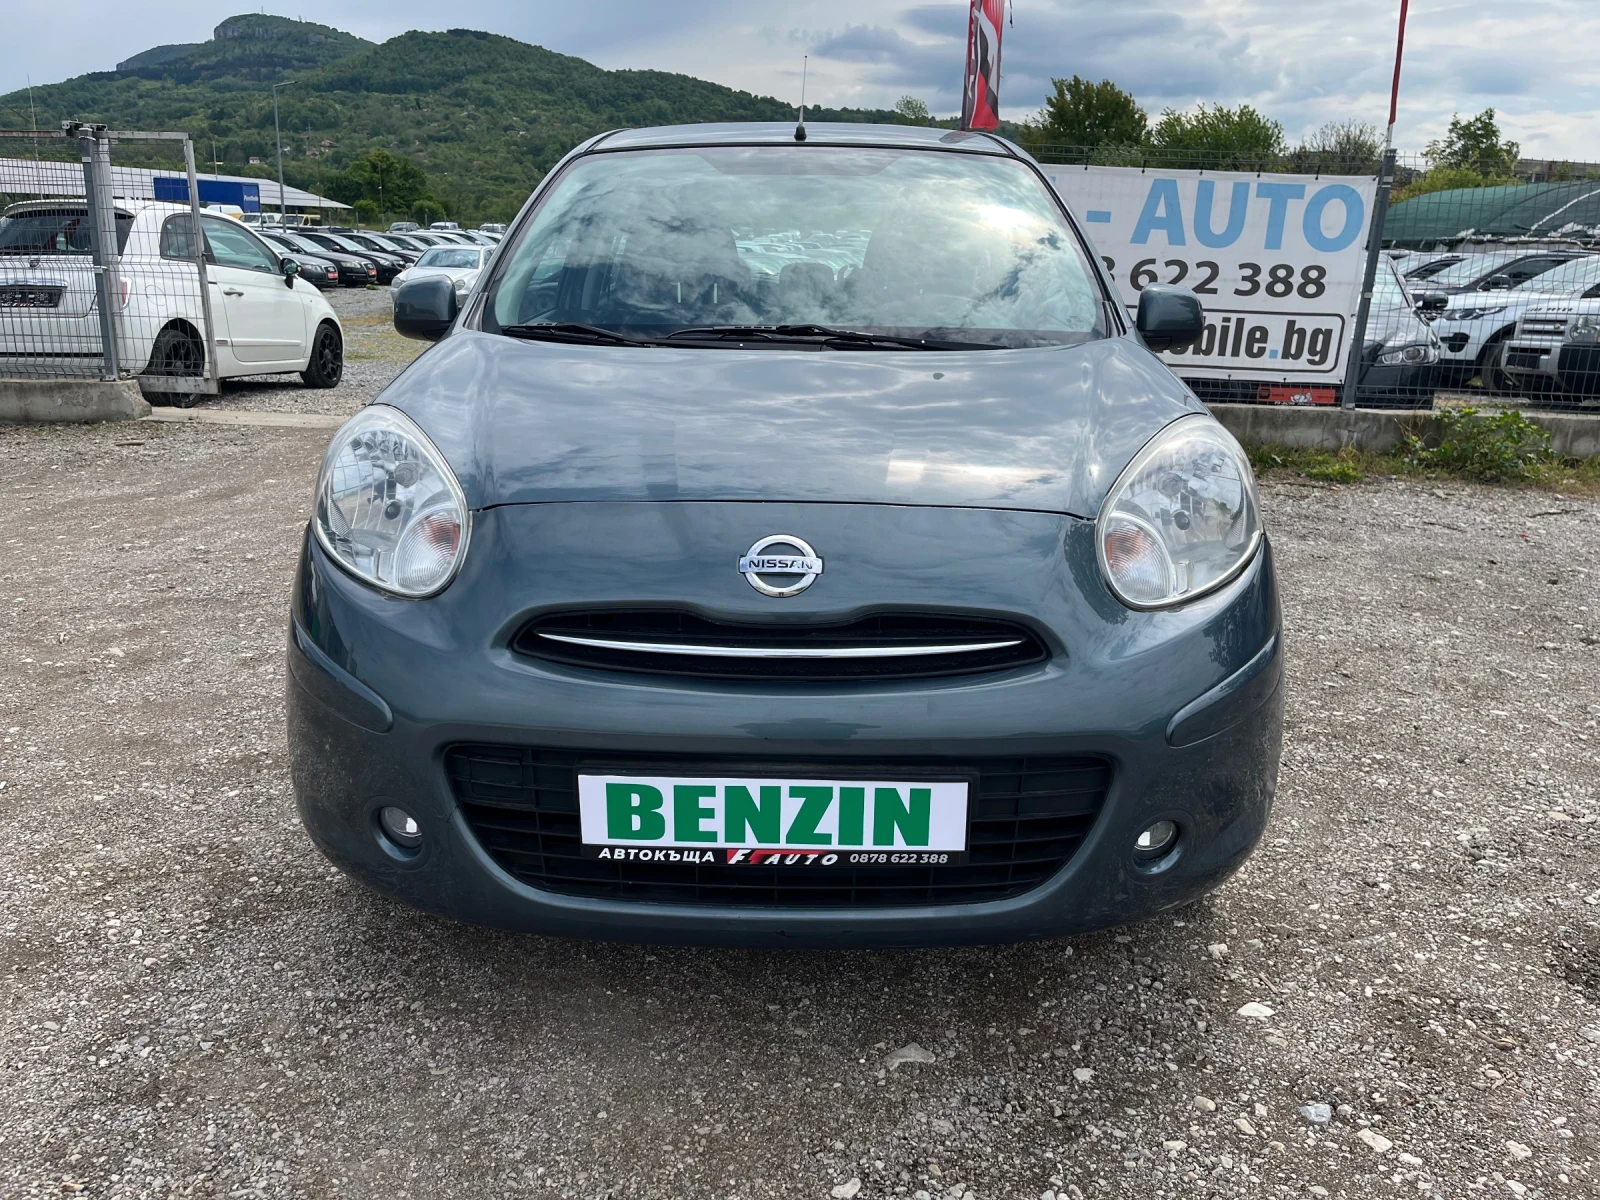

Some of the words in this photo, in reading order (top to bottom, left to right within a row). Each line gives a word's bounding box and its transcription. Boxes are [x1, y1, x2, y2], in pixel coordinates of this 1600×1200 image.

[1130, 178, 1365, 252] AUTO
[1129, 258, 1220, 295] 622
[1233, 262, 1327, 299] 388
[1156, 316, 1333, 366] bile.bg
[605, 782, 932, 847] BENZIN
[598, 847, 715, 864] АВТОКЪЩА
[763, 853, 839, 866] AUTO
[849, 853, 888, 863] 0878
[890, 853, 918, 864] 622
[919, 853, 949, 864] 388
